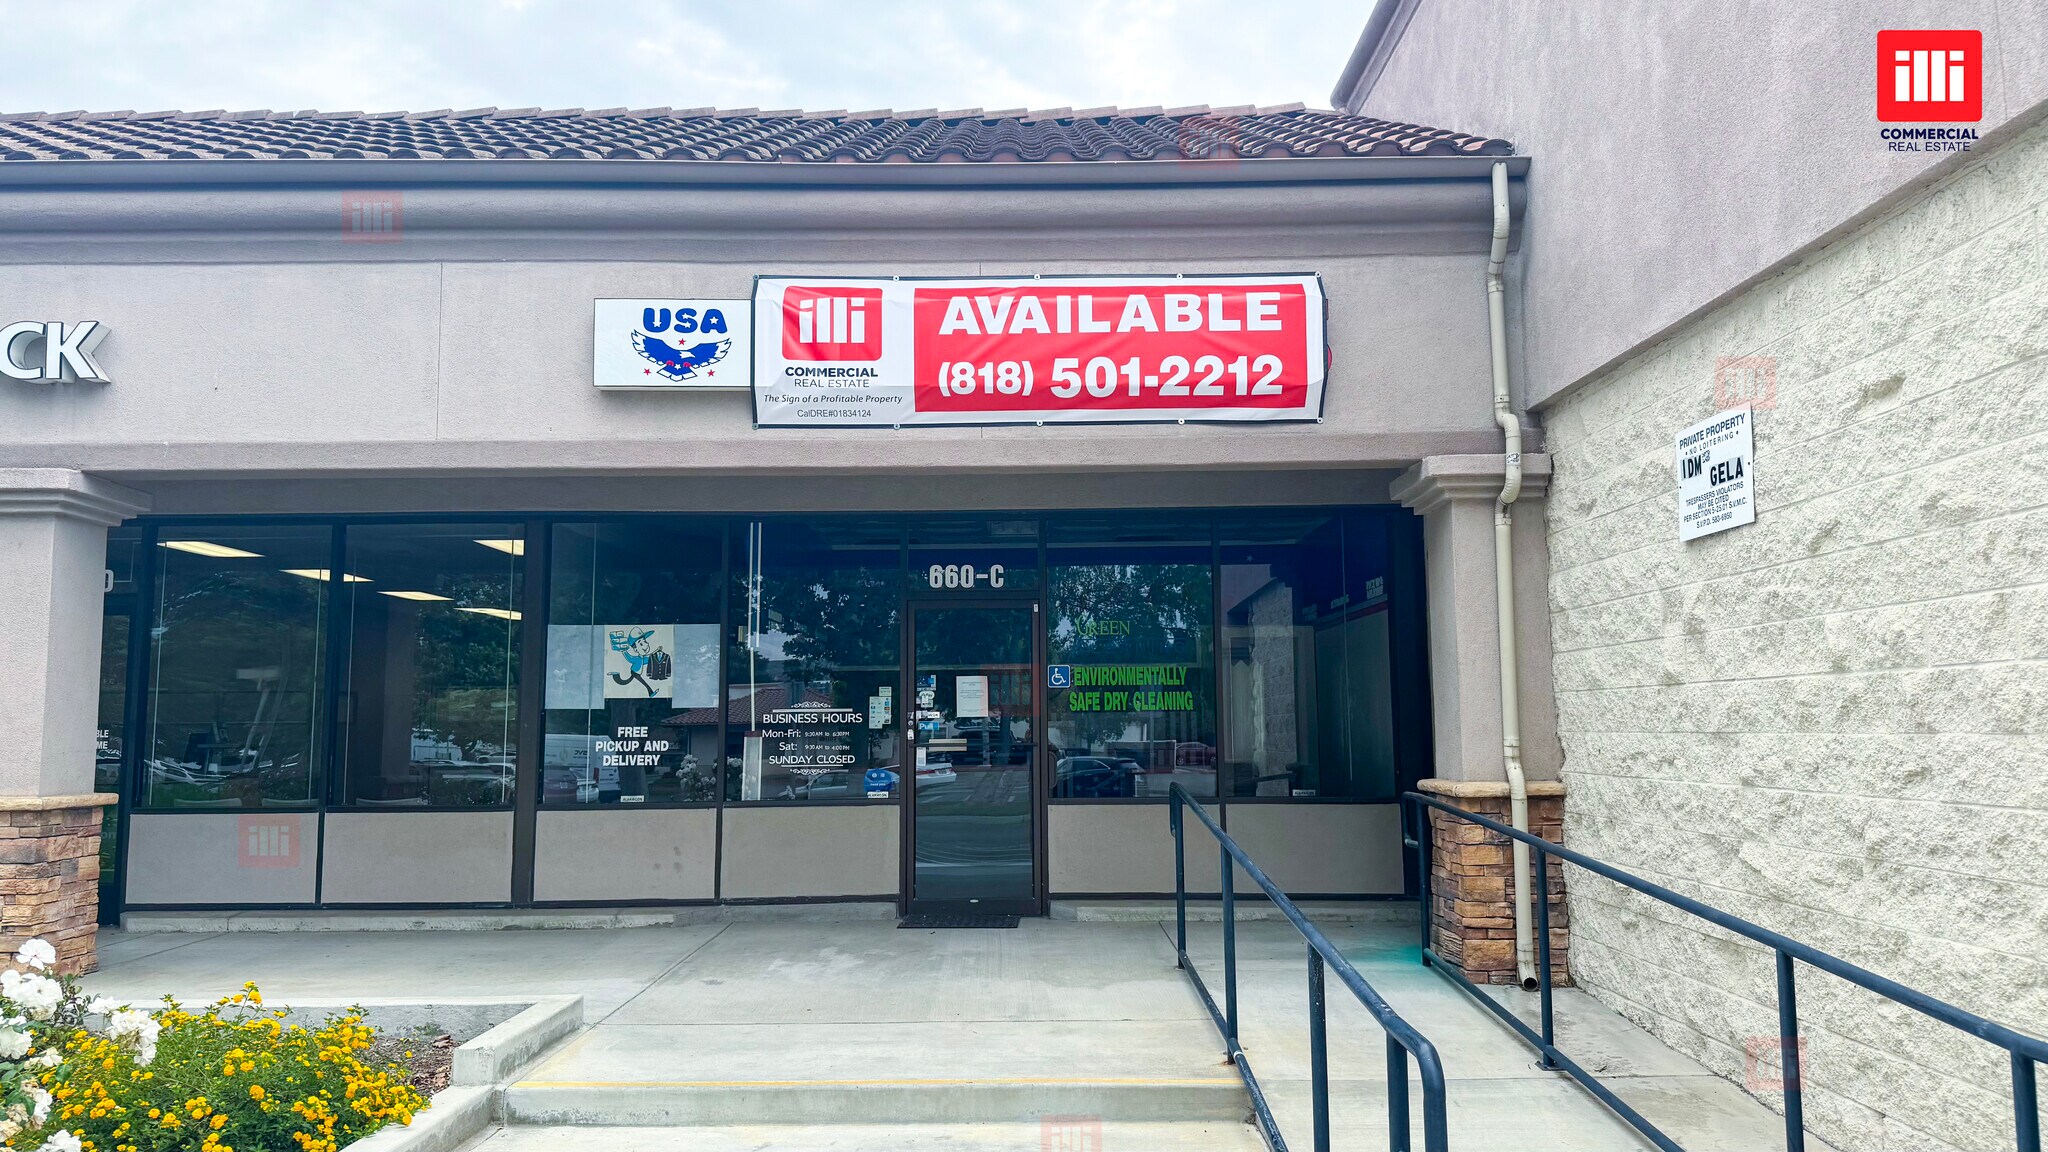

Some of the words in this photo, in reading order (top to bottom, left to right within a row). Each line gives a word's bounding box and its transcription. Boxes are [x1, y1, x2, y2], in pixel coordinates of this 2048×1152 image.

[799, 297, 865, 343] illi
[938, 291, 1282, 336] AVAILABLE
[642, 307, 728, 334] USA
[785, 366, 878, 378] COMMERCIAL
[938, 360, 1034, 397] (818)
[1050, 354, 1284, 399] 501-2212
[794, 378, 824, 388] REAL
[828, 379, 870, 388] ESTATE
[764, 394, 780, 403] The
[781, 394, 800, 405] Sign
[802, 394, 811, 403] of
[818, 394, 864, 403] Profitable
[865, 395, 903, 405] Property
[797, 409, 871, 418] CalDRE#01834124
[1679, 429, 1704, 450] PRIVATE
[1706, 412, 1745, 438] PROPERTY
[1699, 431, 1734, 451] LOITERING
[1710, 457, 1744, 486] GELA
[1716, 480, 1744, 496] VIOLATORS
[1708, 498, 1714, 508] BE
[929, 564, 1004, 589] 660-C
[1074, 666, 1187, 686] ENVIRONMENTALLY
[1069, 692, 1100, 711] SAFE
[1104, 692, 1129, 711] DRY
[1133, 691, 1194, 711] CLEANING
[762, 713, 818, 724] BUSINESS
[822, 713, 863, 723] HOURS
[617, 726, 648, 738] FREE
[762, 729, 801, 738] Mon-Fri:
[595, 740, 640, 752] PICKUP
[643, 740, 669, 752] AND
[778, 741, 798, 751] Sat:
[602, 754, 661, 767] DELIVERY
[768, 755, 813, 765] SUNDAY
[816, 755, 856, 764] CLOSED
